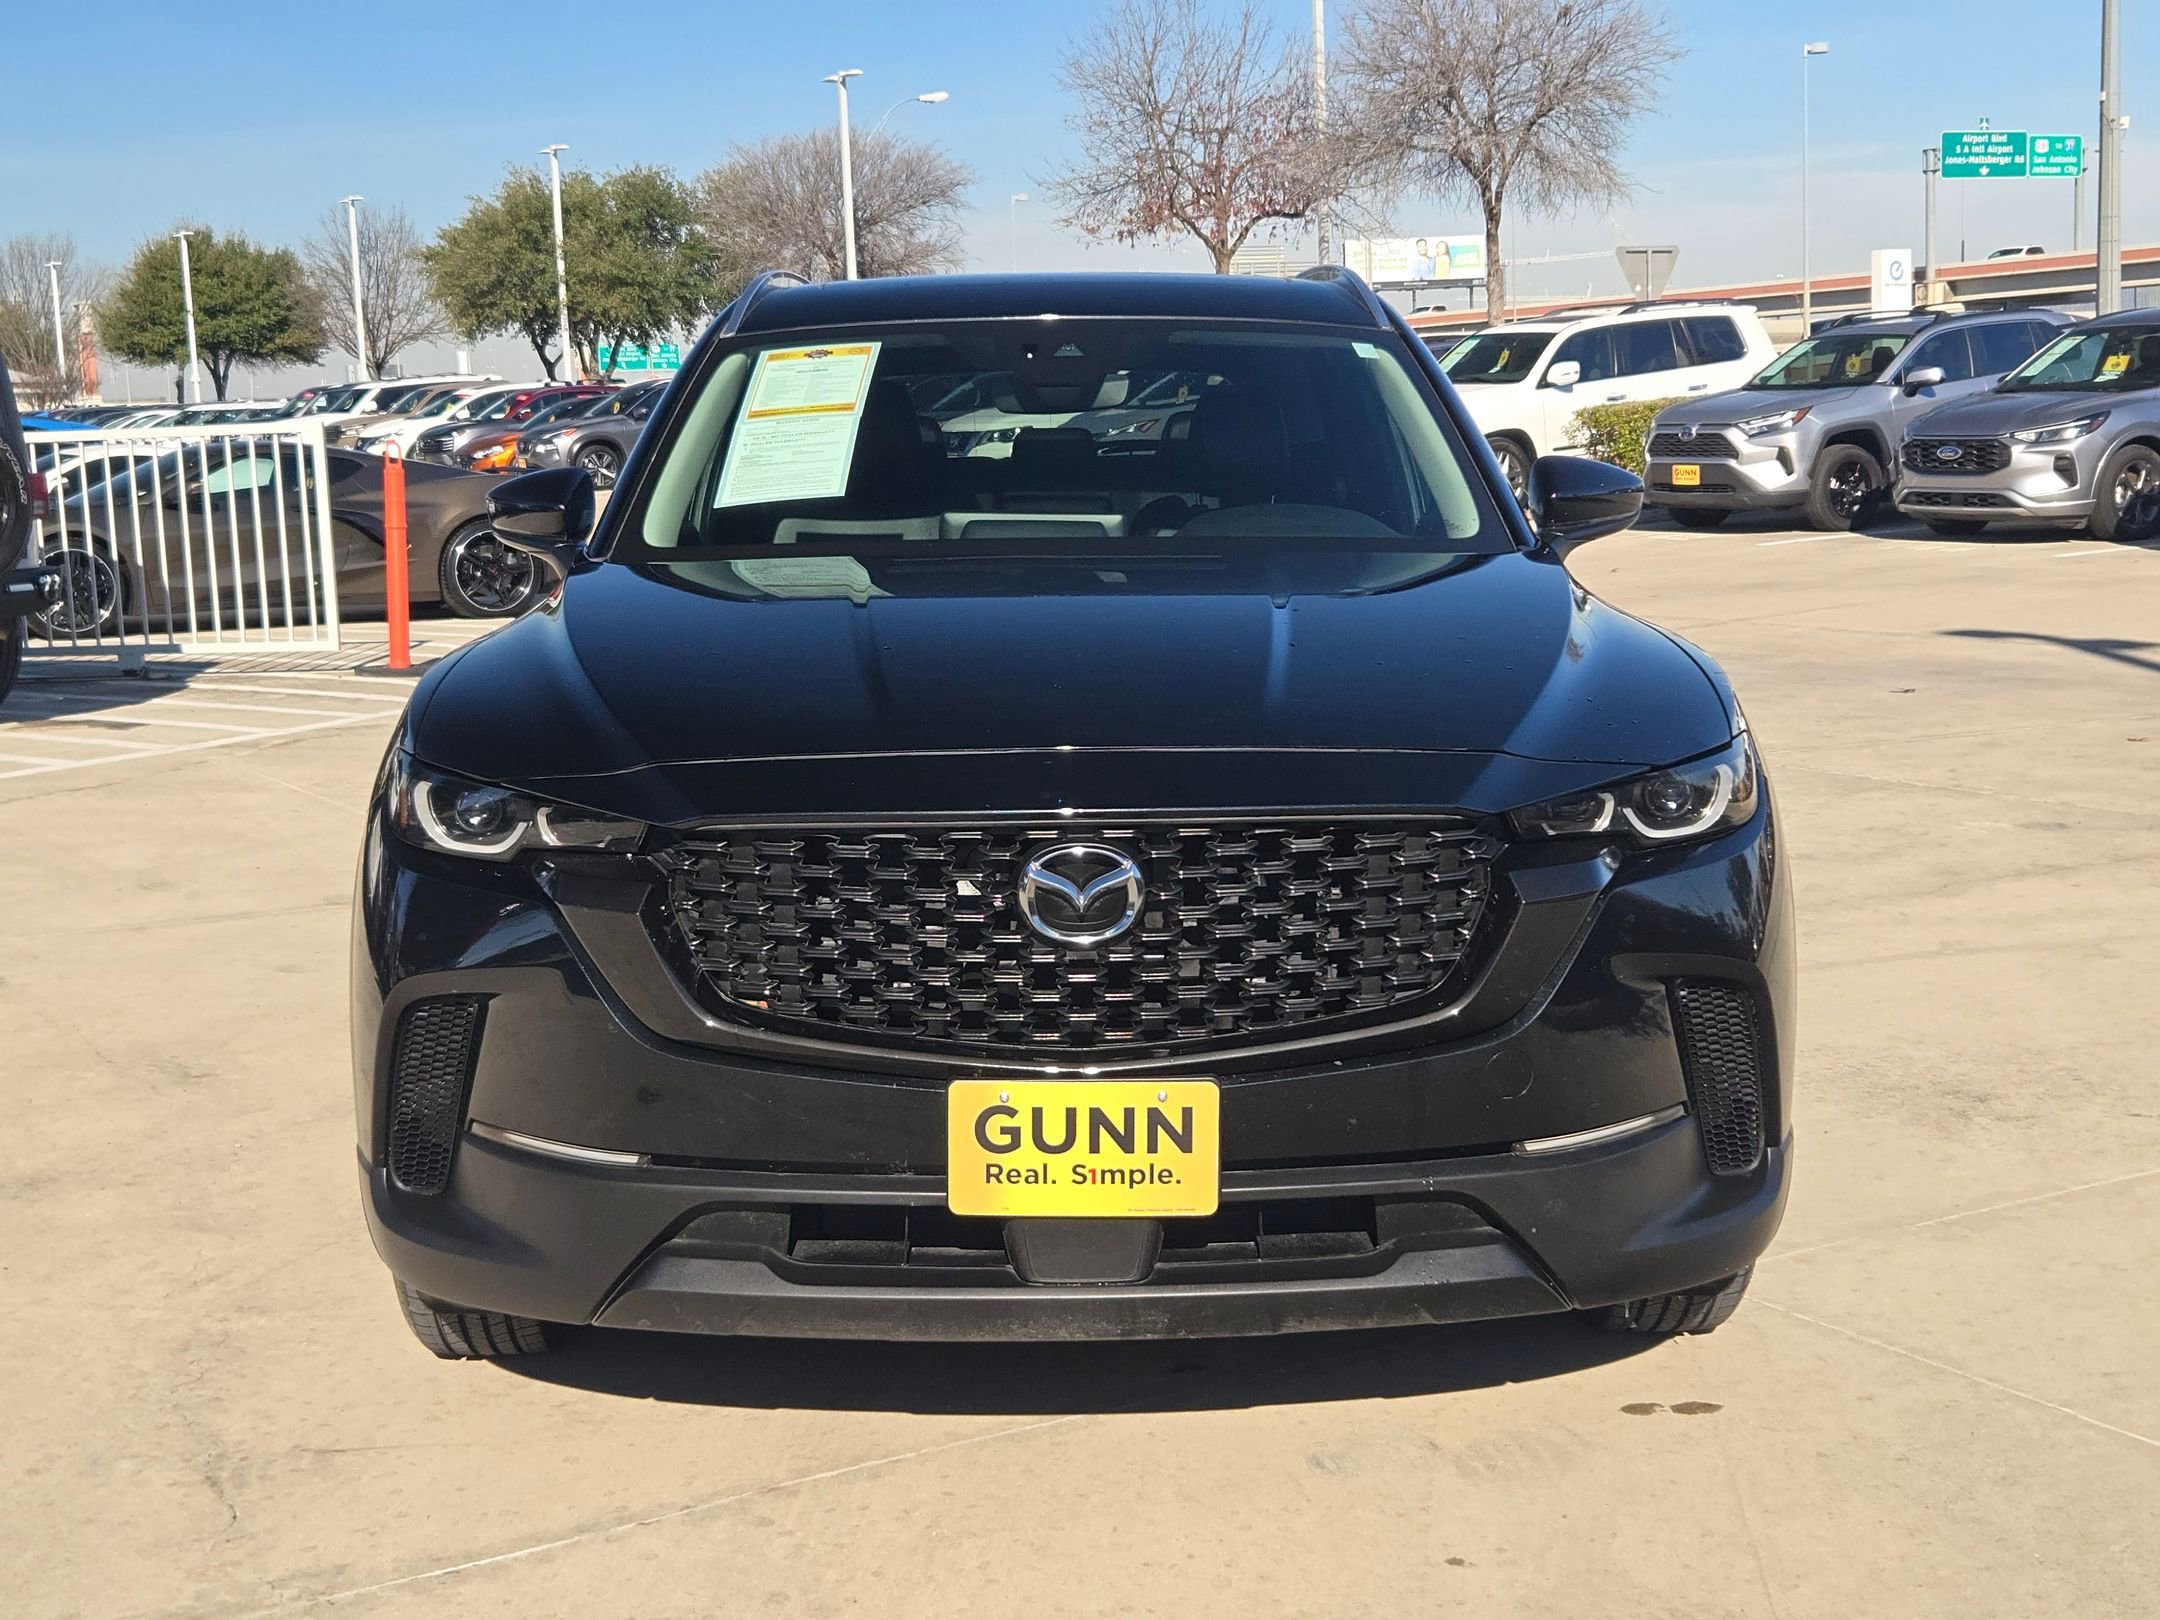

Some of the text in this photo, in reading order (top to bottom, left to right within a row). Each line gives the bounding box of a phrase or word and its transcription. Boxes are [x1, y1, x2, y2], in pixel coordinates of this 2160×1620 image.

[1962, 134, 2008, 144] Airport Blvd
[1963, 145, 1969, 153] A
[1987, 145, 2014, 154] Airport
[2033, 155, 2077, 163] San Antonio
[2031, 165, 2078, 175] Johnson City
[1674, 468, 1697, 477] GUNN
[974, 1104, 1193, 1154] GUNN
[985, 1163, 1057, 1185] Real.
